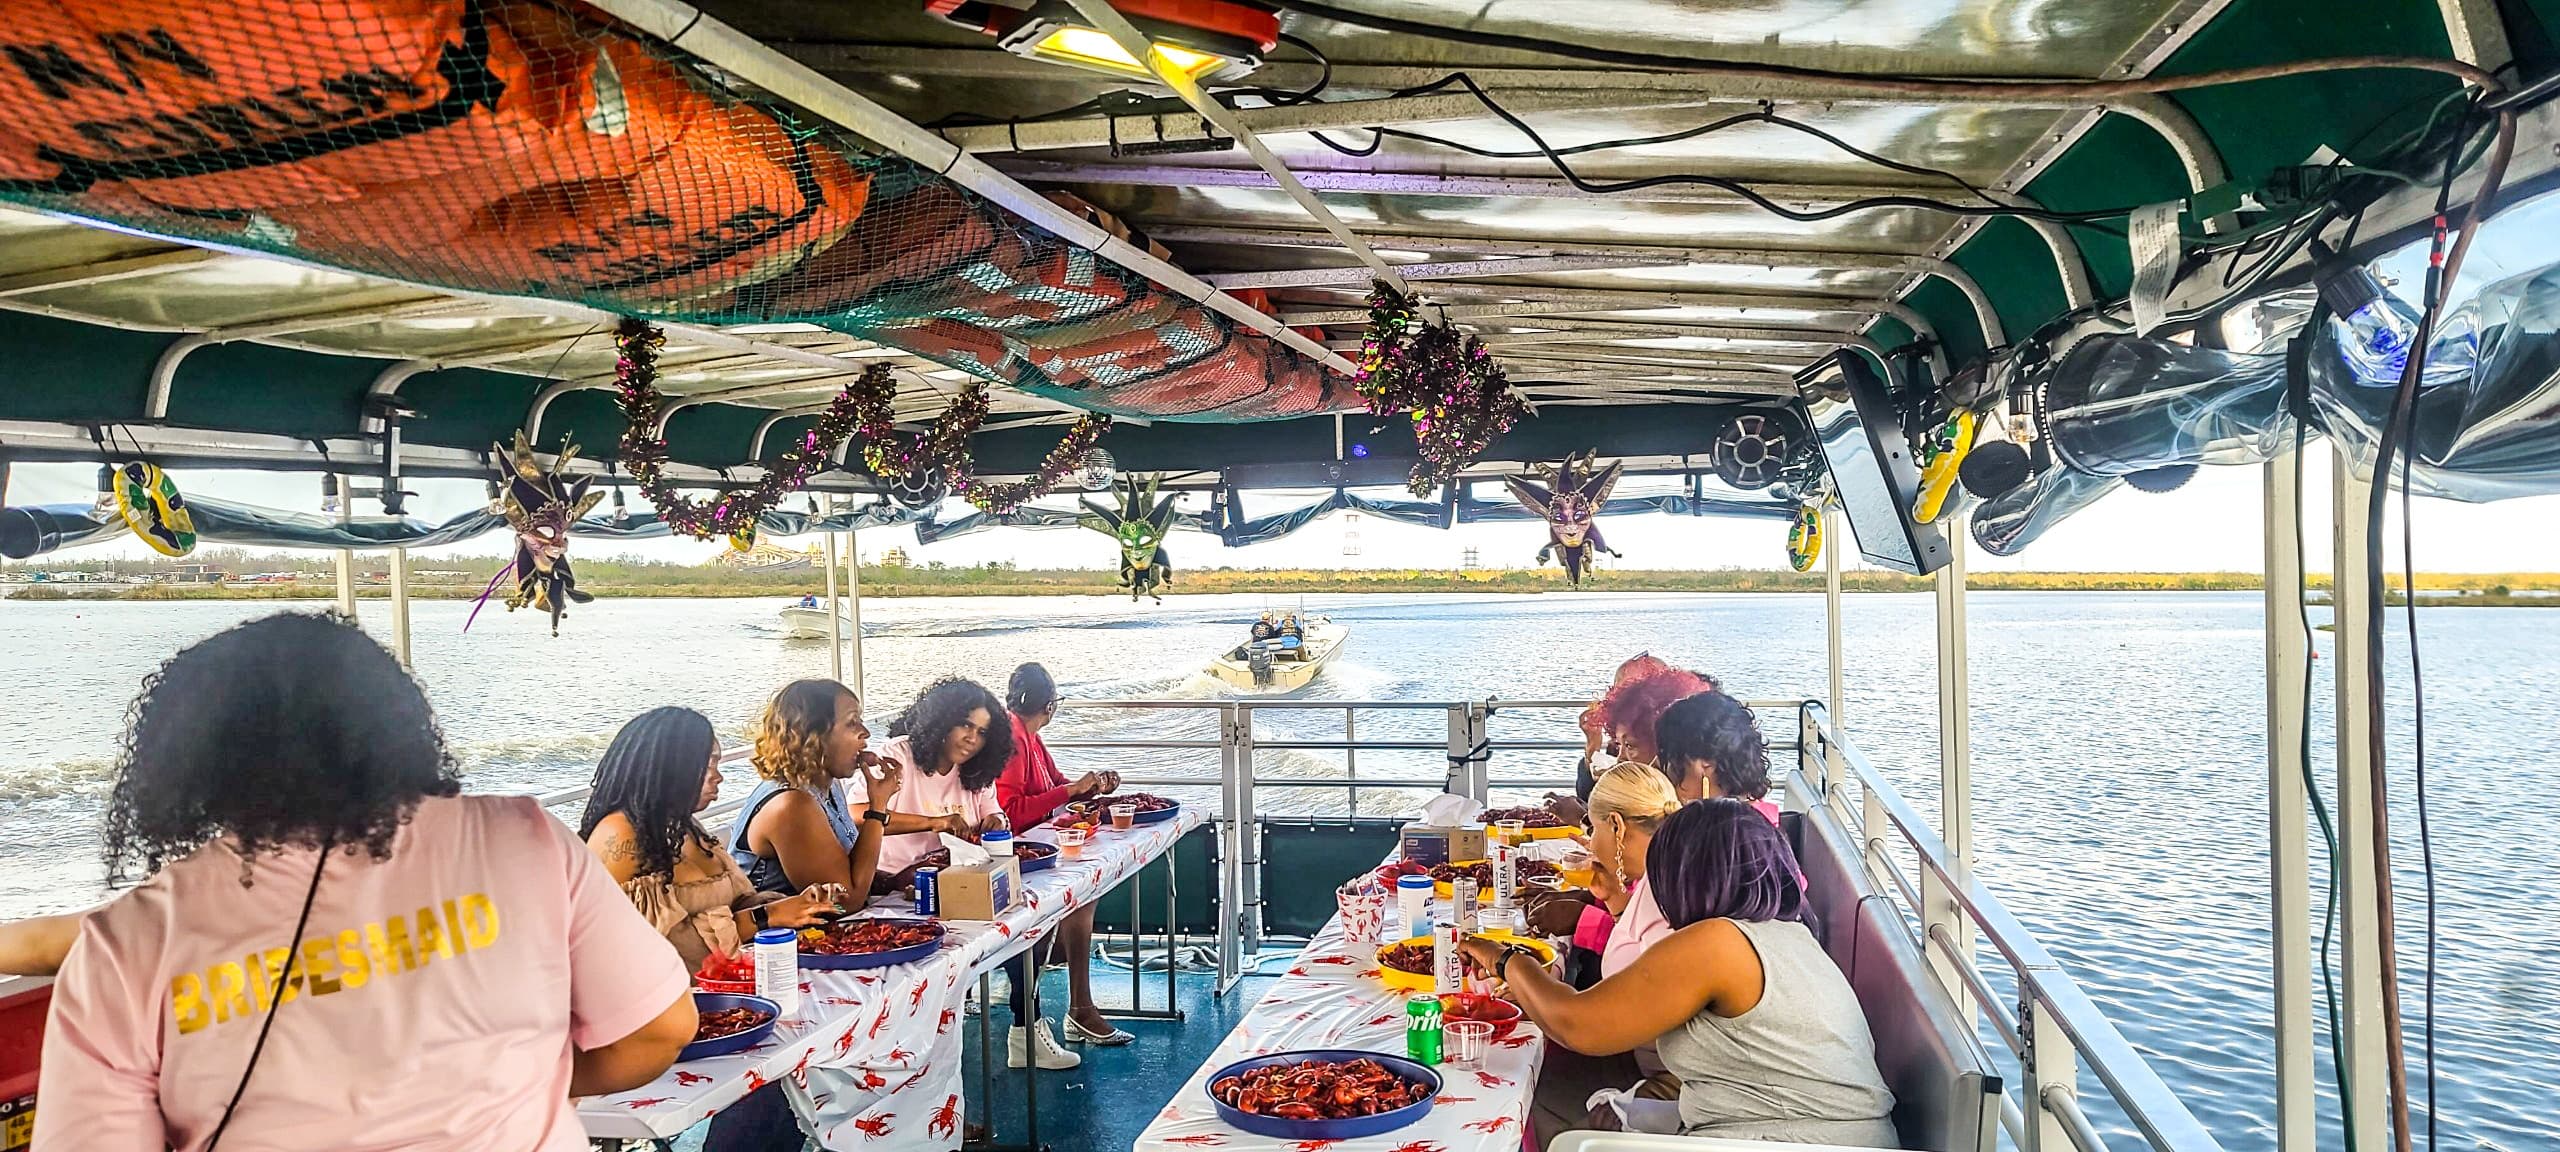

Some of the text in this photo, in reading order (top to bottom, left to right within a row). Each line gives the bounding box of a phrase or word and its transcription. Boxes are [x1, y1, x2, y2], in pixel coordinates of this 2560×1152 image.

[1500, 865, 1508, 898] ULTRA
[172, 893, 500, 1034] BRIDESMAID
[1452, 948, 1460, 988] ULTRA
[1407, 1010, 1443, 1031] prite
